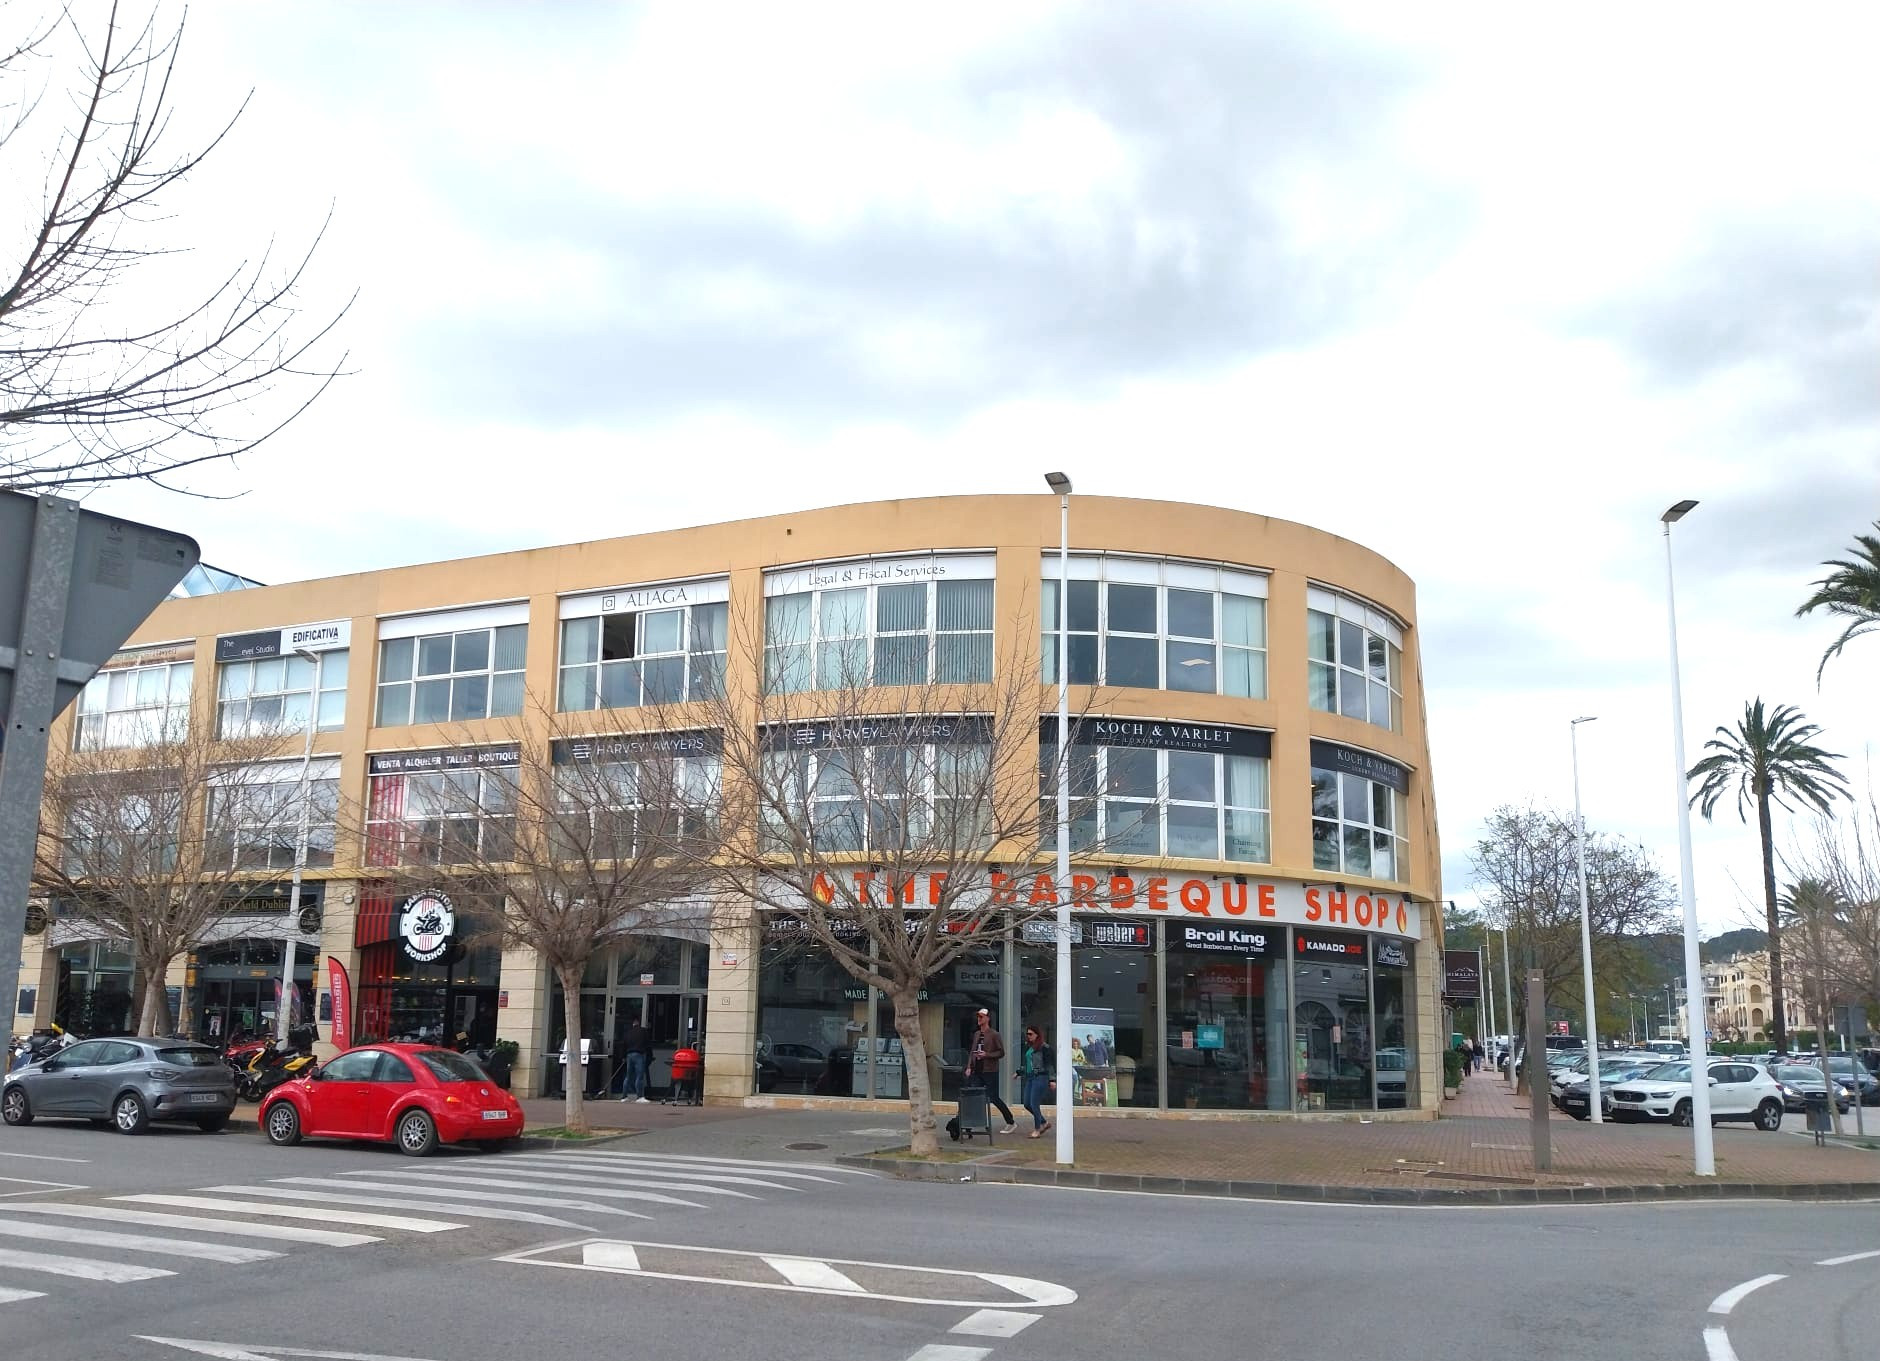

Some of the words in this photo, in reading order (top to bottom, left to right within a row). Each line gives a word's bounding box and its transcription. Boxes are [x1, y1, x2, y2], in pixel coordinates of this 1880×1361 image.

[809, 572, 837, 586] Legal
[842, 569, 852, 582] &
[858, 566, 891, 580] Fiscal
[895, 563, 946, 577] Services
[624, 587, 688, 608] ALIAGA
[223, 640, 235, 648] The
[292, 627, 339, 643] EDIFICATIVA
[255, 645, 277, 654] Studio
[1096, 721, 1144, 735] KOCH
[1152, 725, 1164, 736] &
[1171, 726, 1233, 743] VARLET
[1164, 740, 1208, 748] REALTORS
[377, 759, 401, 769] VENTA
[405, 756, 441, 768] ALQUILER
[478, 751, 519, 762] BOUTIQUE
[1337, 749, 1363, 766] KOCH
[853, 872, 947, 905] THE
[991, 873, 1276, 917] BARBEQUE
[1305, 888, 1389, 928] SHOP
[1096, 922, 1135, 943] weber
[1185, 928, 1225, 942] Broil
[1229, 930, 1265, 946] King
[403, 942, 447, 962] WORKSHOP
[845, 989, 867, 999] MADE
